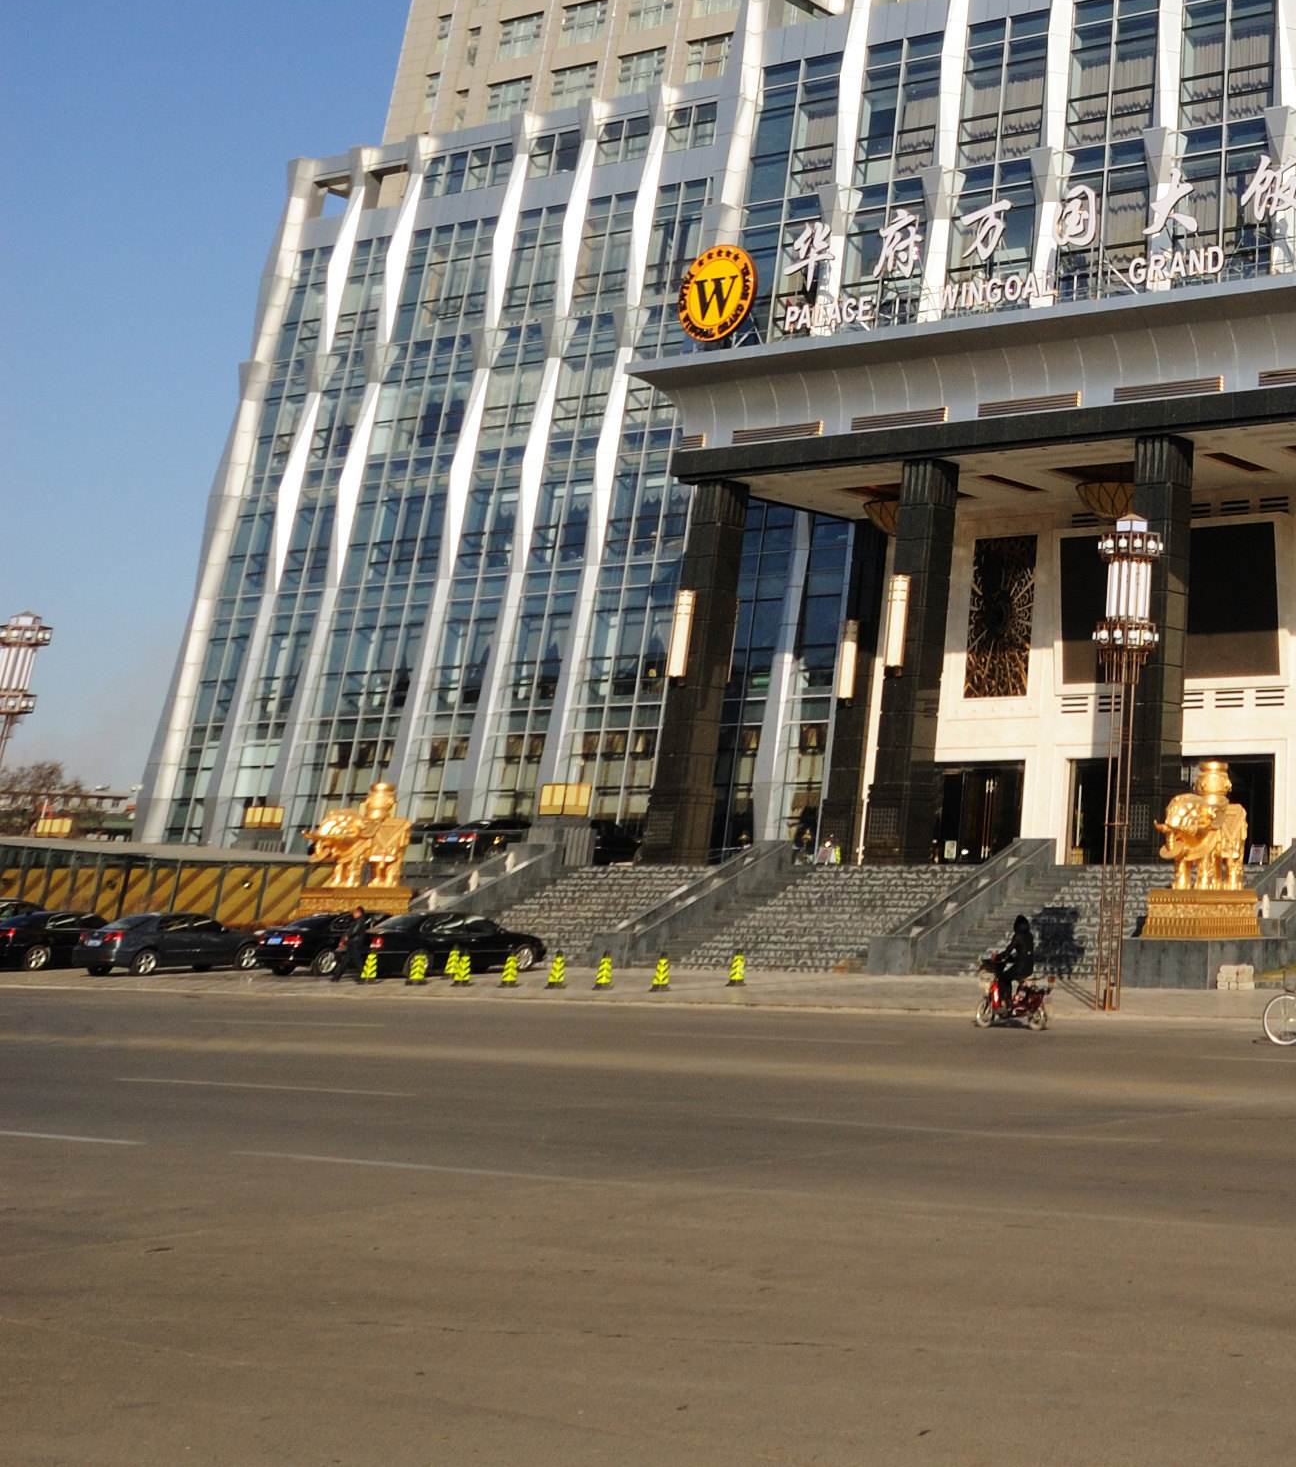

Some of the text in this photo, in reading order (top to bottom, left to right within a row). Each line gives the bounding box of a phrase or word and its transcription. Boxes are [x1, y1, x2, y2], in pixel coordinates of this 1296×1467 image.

[695, 275, 738, 321] W
[784, 294, 875, 332] PALACE
[939, 272, 1057, 310] WINGOAL
[1129, 245, 1224, 285] GRAND
